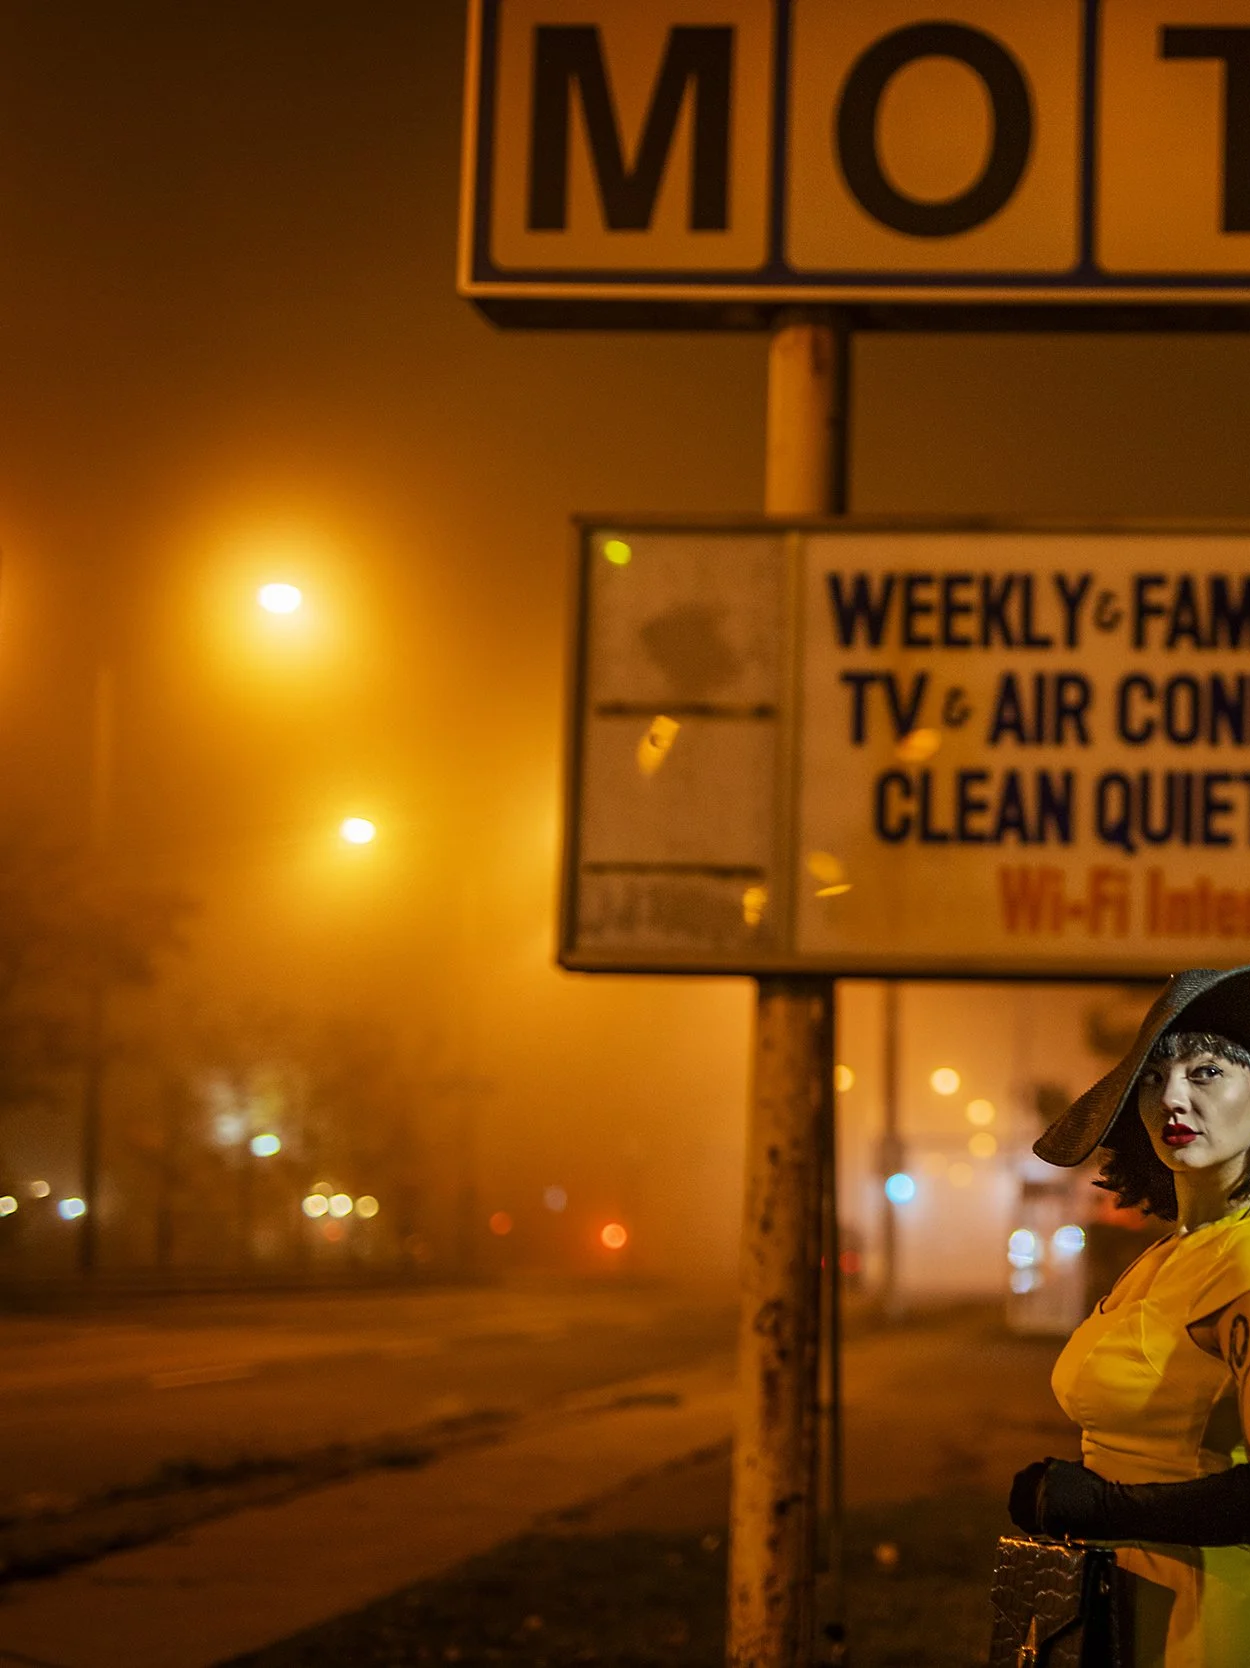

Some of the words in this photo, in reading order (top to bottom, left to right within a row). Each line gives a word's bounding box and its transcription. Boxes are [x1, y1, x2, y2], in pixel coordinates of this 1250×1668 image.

[826, 571, 1092, 649] WEEKLY
[839, 671, 930, 747] TV
[987, 671, 1092, 748] AIR
[873, 769, 1073, 845] CLEAN
[999, 863, 1132, 938] Wi-Fi
